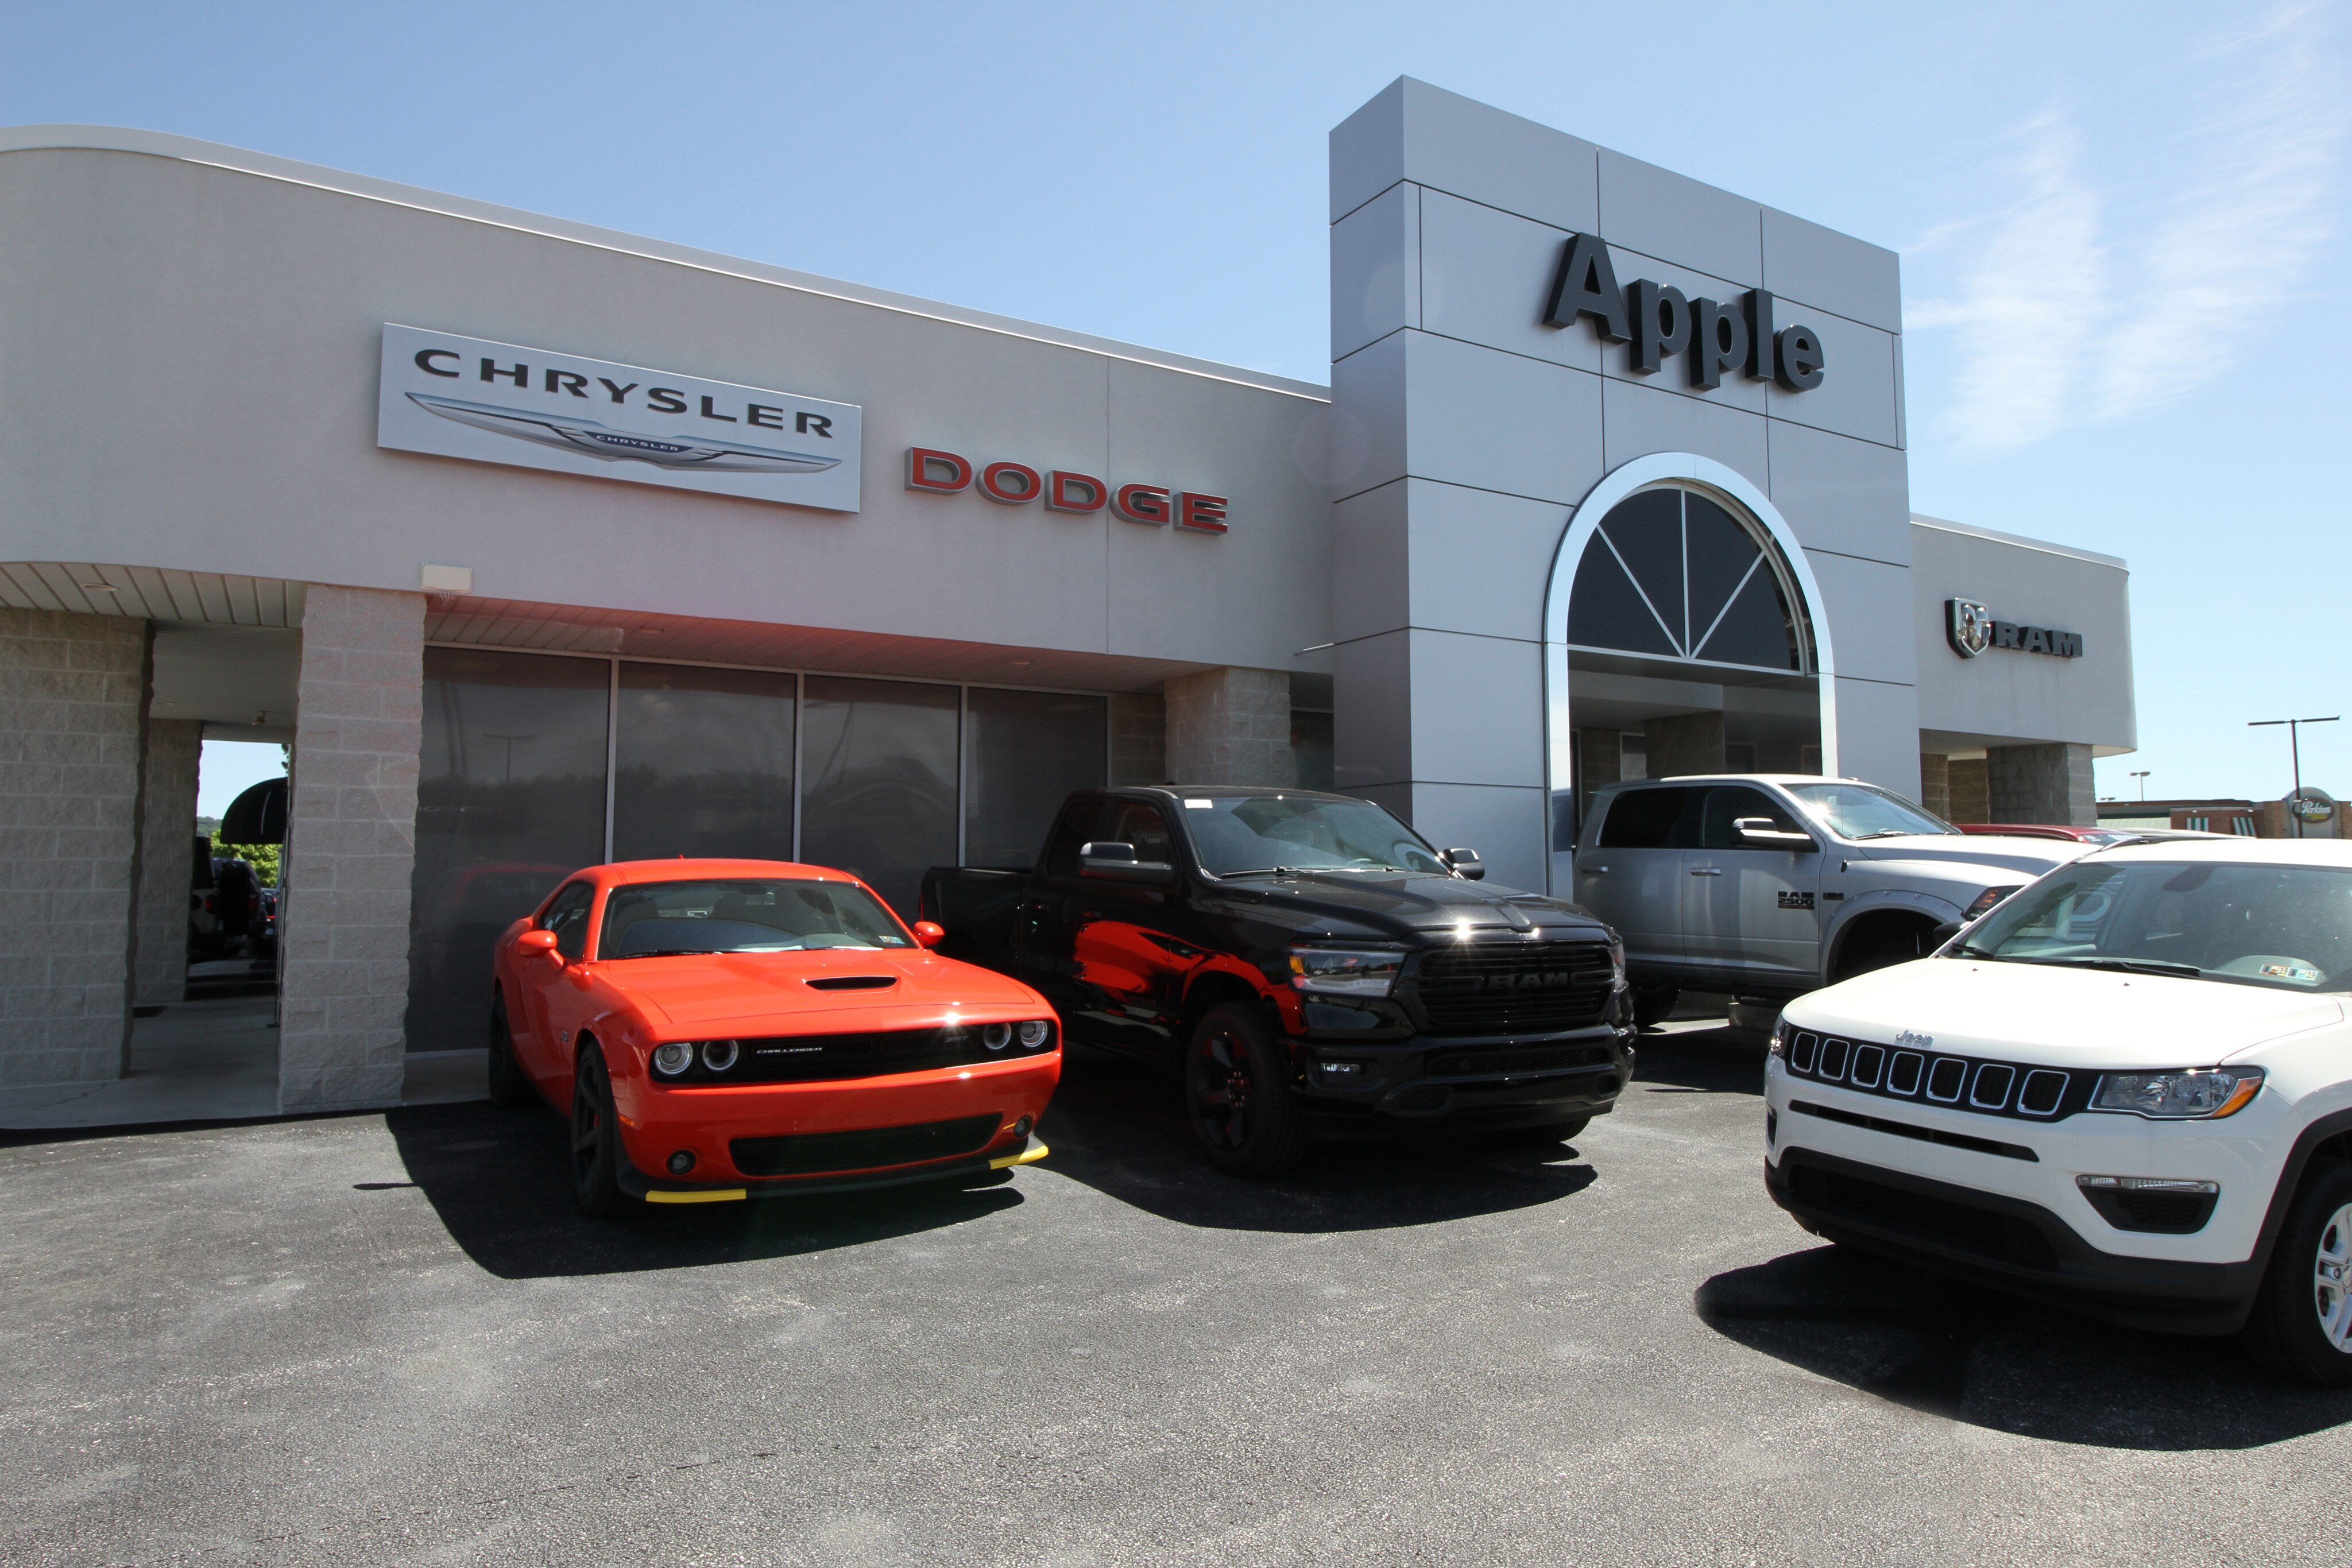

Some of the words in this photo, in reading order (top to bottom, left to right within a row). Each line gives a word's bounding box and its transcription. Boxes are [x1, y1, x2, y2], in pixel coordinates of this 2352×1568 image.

[1542, 233, 1824, 394] Apple
[414, 349, 834, 439] CHRYSLER
[596, 435, 679, 451] CHRYSLER
[905, 446, 1228, 536] DODGE
[1988, 620, 2083, 659] RAM
[2301, 800, 2331, 814] Perkins
[1777, 897, 1815, 905] 2500
[1488, 972, 1568, 989] RAM
[2306, 971, 2316, 979] 19
[1895, 1029, 1934, 1046] Jeep
